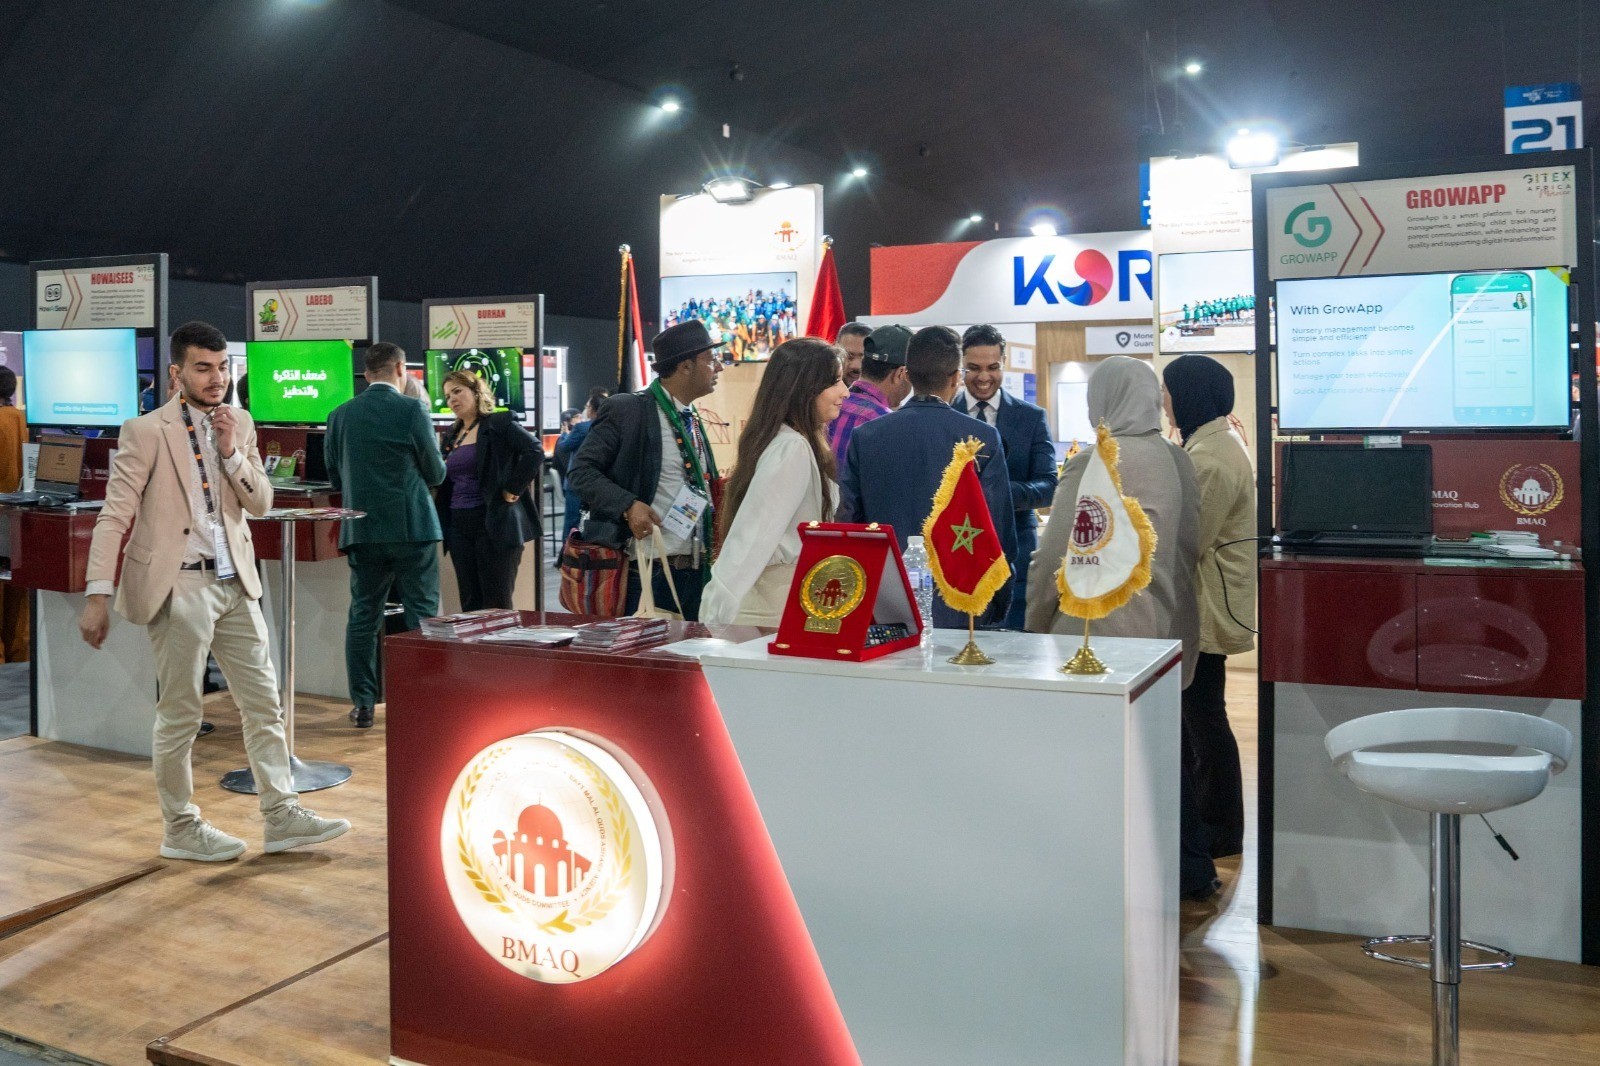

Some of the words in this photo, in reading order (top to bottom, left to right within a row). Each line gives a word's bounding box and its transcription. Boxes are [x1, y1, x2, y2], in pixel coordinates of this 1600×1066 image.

[1511, 116, 1576, 155] 21
[1523, 171, 1571, 184] GITEX
[1406, 184, 1506, 210] GROWAPP
[1483, 209, 1512, 218] platform
[1280, 252, 1338, 265] GROWAPP
[91, 271, 134, 285] HOWAISEES
[306, 294, 333, 306] LABEBO
[1290, 304, 1319, 315] With
[1323, 303, 1383, 315] GrowApp
[1292, 327, 1322, 335] Nursery
[1324, 325, 1376, 334] management
[1378, 324, 1415, 332] becomes
[1312, 350, 1345, 358] complex
[1347, 349, 1368, 357] tasks
[1370, 348, 1385, 356] into
[1387, 348, 1413, 356] simple
[1516, 517, 1547, 526] BMAQ
[1071, 556, 1100, 566] BMAQ
[583, 789, 595, 805] MAL
[592, 805, 600, 816] AL
[596, 817, 606, 840] QUDS
[503, 883, 511, 892] AL
[512, 891, 530, 904] QUDS
[501, 936, 581, 978] BMAQ
